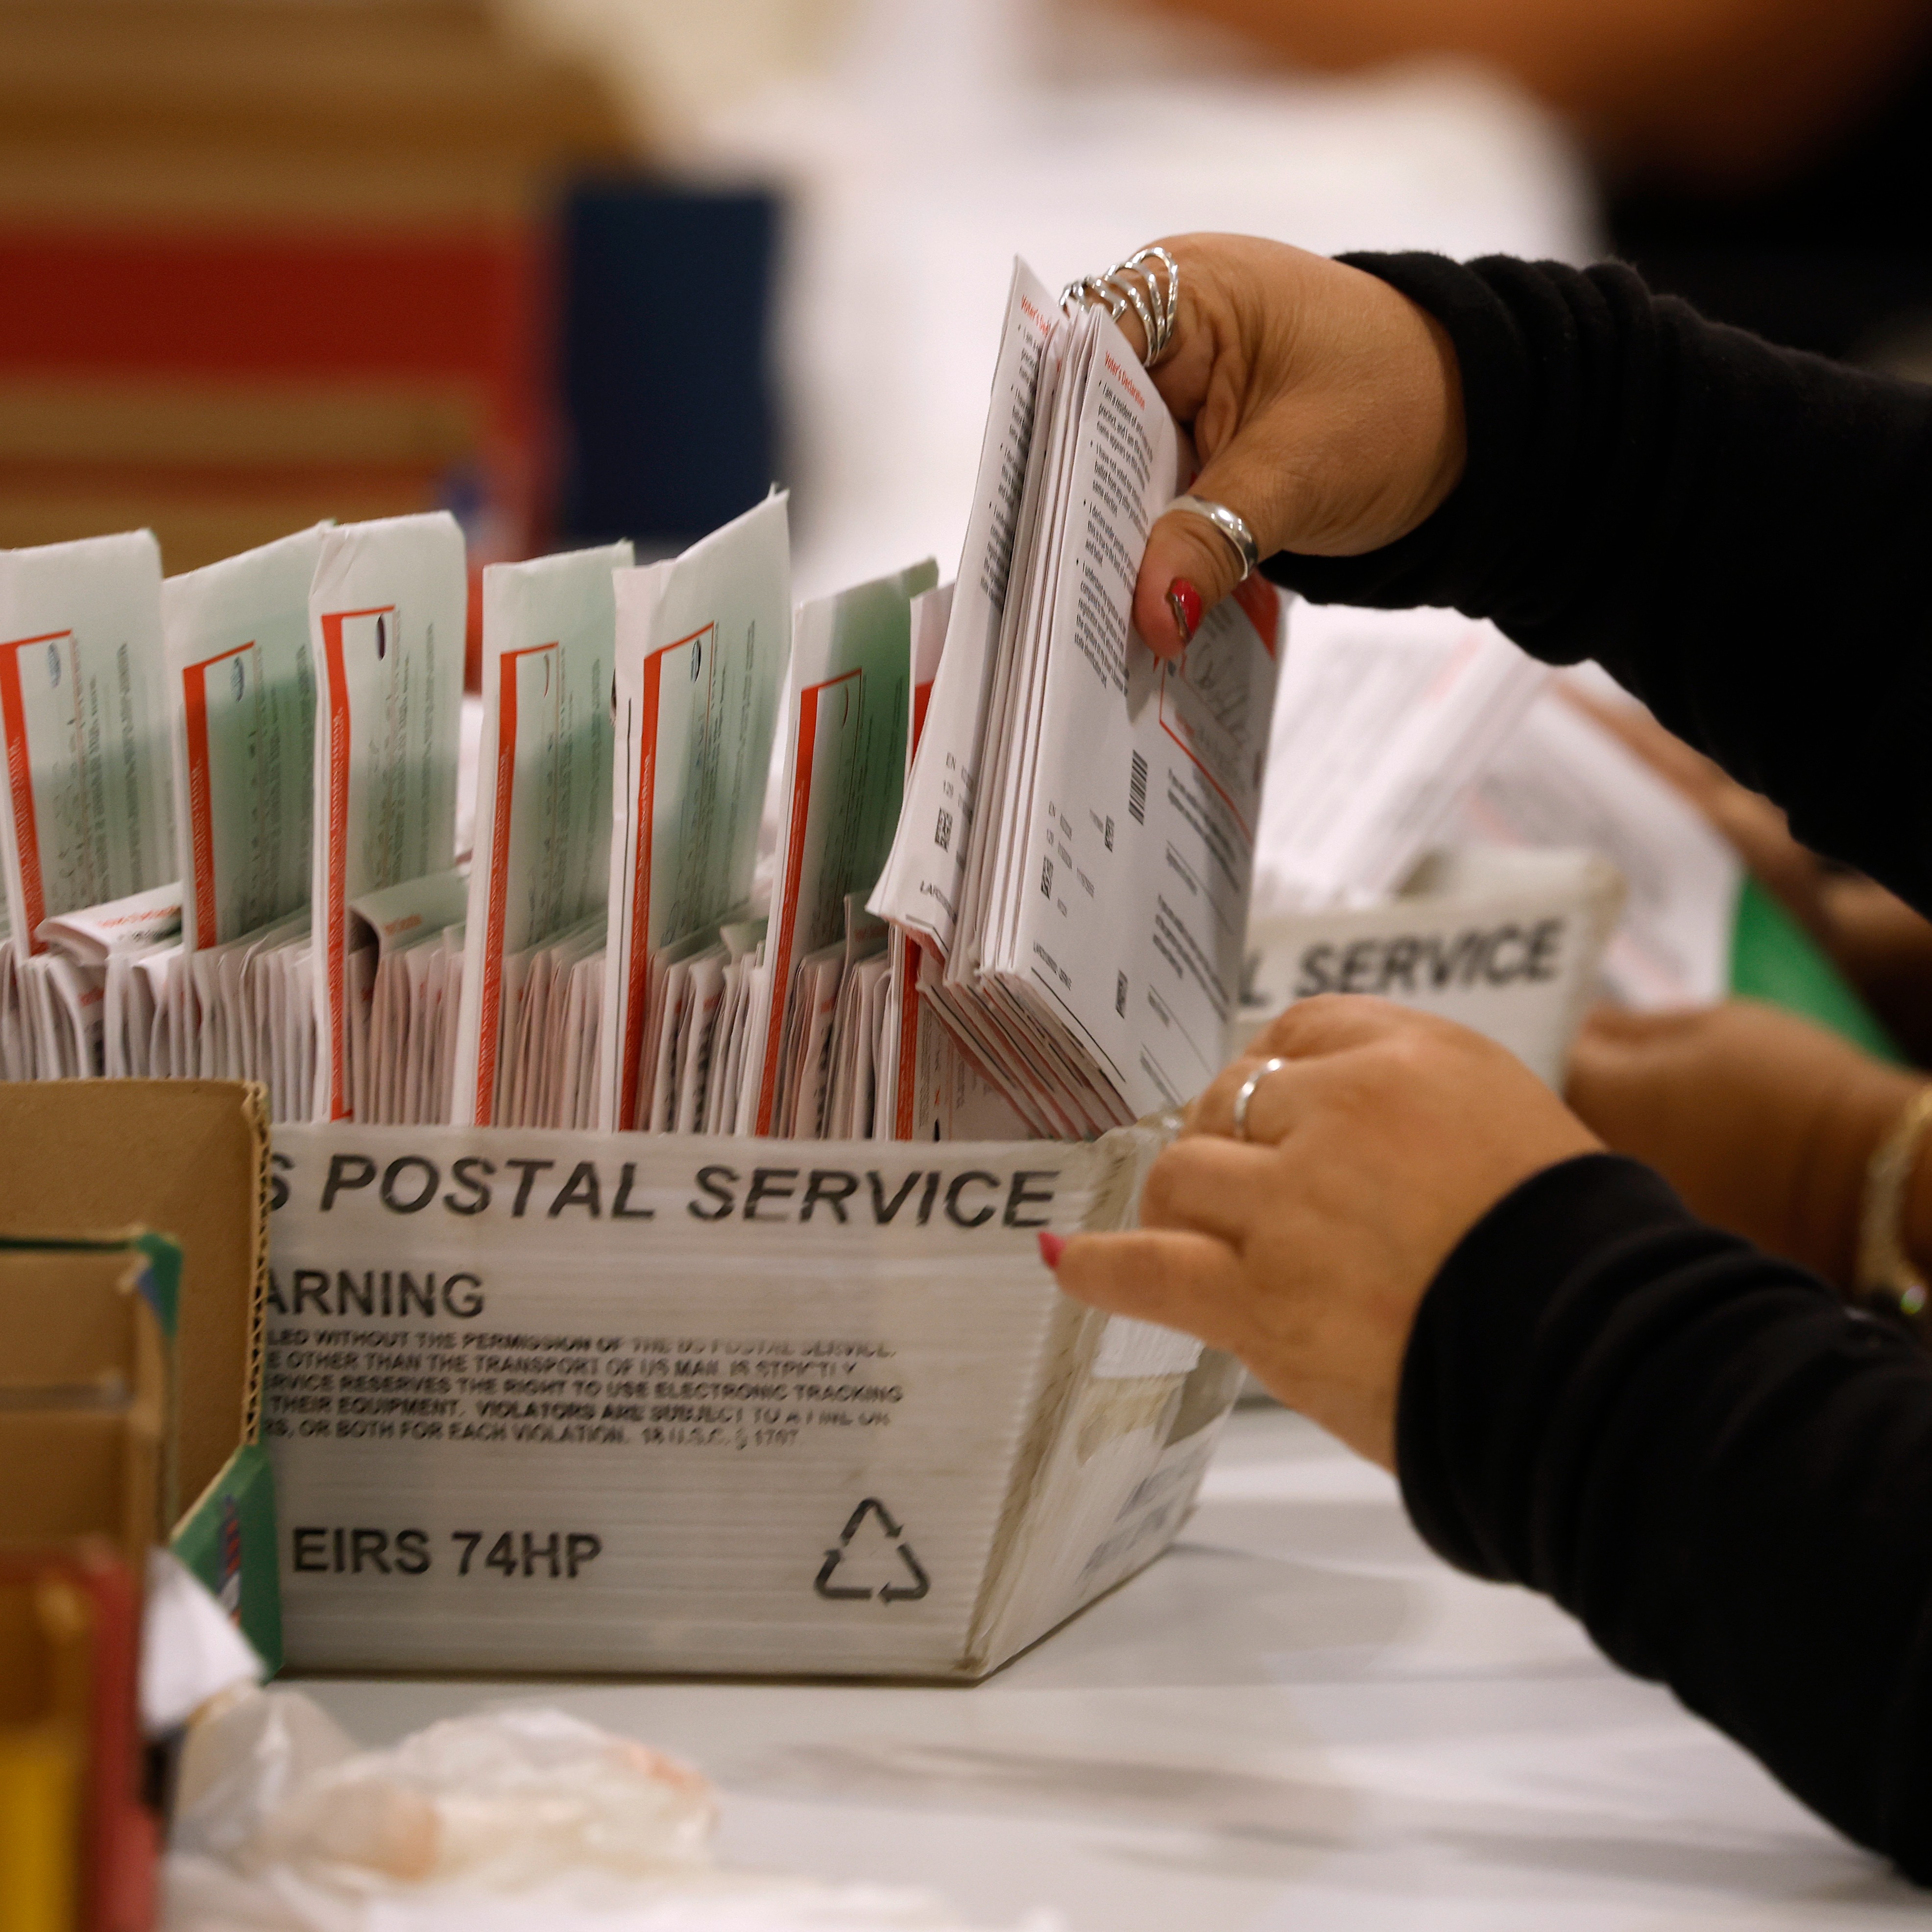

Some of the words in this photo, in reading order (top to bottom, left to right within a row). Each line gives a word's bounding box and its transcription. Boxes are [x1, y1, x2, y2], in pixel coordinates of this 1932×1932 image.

[1296, 919, 1564, 997] SERVICE
[268, 1154, 294, 1211] S
[320, 1154, 656, 1219] POSTAL
[688, 1164, 1062, 1228] SERVICE
[267, 1269, 484, 1318] ARNING
[269, 1328, 308, 1345] LED
[314, 1329, 408, 1348] WITHOUT
[416, 1331, 457, 1349] THE
[463, 1332, 590, 1351] PERMISSION
[596, 1336, 621, 1353] OF
[267, 1351, 281, 1369] E
[286, 1351, 358, 1370] OTHER
[366, 1352, 421, 1370] THAN
[427, 1354, 468, 1372] THE
[474, 1355, 599, 1375] TRANSPORT
[605, 1357, 634, 1377] OF
[265, 1374, 335, 1392] ERVICE
[340, 1375, 452, 1395] RESERVES
[457, 1377, 497, 1395] THE
[503, 1377, 566, 1396] RIGHT
[571, 1379, 602, 1398] TO
[606, 1381, 648, 1400] USE
[654, 1381, 787, 1401] ELECTRONIC
[794, 1383, 903, 1404] TRACKING
[475, 1399, 595, 1420] VIOLATORS
[600, 1403, 646, 1423] ARE
[649, 1404, 743, 1424] SUBJECT
[299, 1420, 331, 1439] OR
[336, 1419, 395, 1439] BOTH
[399, 1420, 443, 1441] FOR
[448, 1422, 507, 1442] EACH
[293, 1527, 431, 1576] EIRS
[451, 1530, 603, 1578] 74HP
